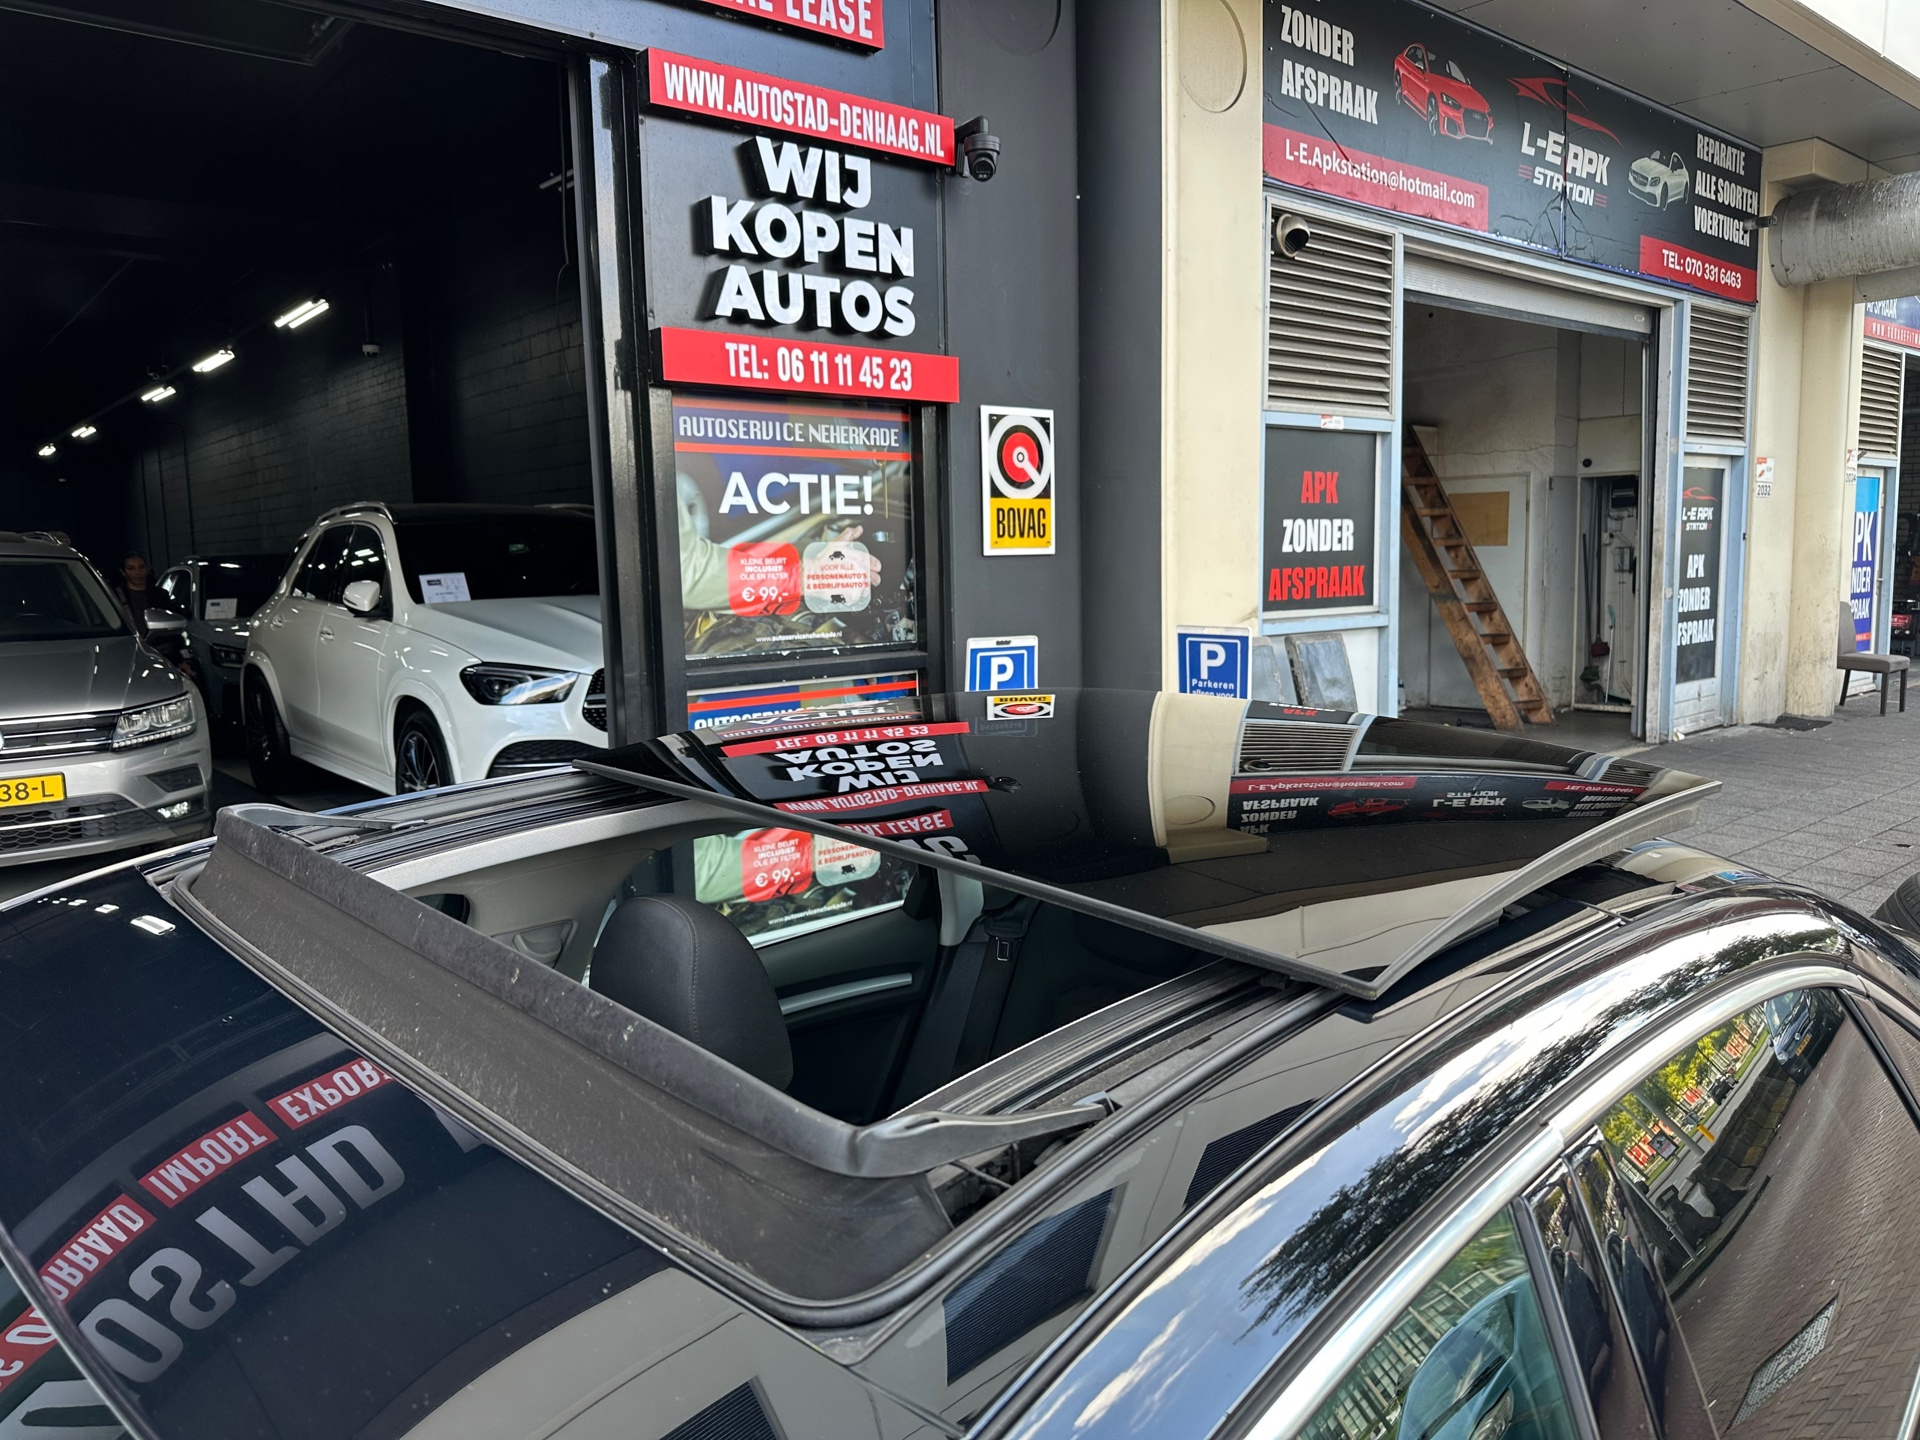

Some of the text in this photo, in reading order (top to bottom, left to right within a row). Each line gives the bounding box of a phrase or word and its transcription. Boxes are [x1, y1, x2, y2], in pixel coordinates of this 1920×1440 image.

[1281, 5, 1354, 67] ZONDER
[1281, 58, 1378, 125] AFSPRAAK
[663, 61, 944, 158] WWW.AUTOSTAD-DENHAAG.NL
[1566, 142, 1610, 186] APK
[1697, 133, 1745, 176] REPARATIE
[755, 136, 872, 208] WIJ
[1285, 138, 1474, 209] L-E.Apkstation@hotmail.com
[1533, 166, 1594, 206] STATION
[1695, 170, 1758, 215] ALLE SOORTEN
[711, 195, 914, 277] KOPEN
[1662, 249, 1742, 289] TEL: 070 331 6463
[715, 265, 915, 337] AUTOS
[725, 342, 912, 391] TEL: 06 11 11 45 23
[679, 416, 899, 447] AUTOSERVICE NEHERKADE
[718, 471, 874, 516] ACTIE!
[1301, 471, 1339, 504] APK
[1757, 485, 1771, 496] 2032
[996, 507, 1047, 539] BOVAG
[1697, 507, 1714, 520] APK
[1282, 518, 1354, 553] ZONDER
[740, 573, 755, 581] OLIE
[767, 572, 789, 580] FILTER
[807, 573, 867, 581] PERSONENAUTO'S
[1268, 565, 1365, 601] AFSPRAAK
[1686, 554, 1705, 578] APK
[741, 586, 789, 603] € 99,-
[813, 582, 869, 590] BEDRIJFSAUTO'S
[1678, 587, 1710, 613] ZONDER
[756, 631, 842, 643] www.autoserviceneherkade.nl
[1200, 643, 1227, 680] P
[1192, 678, 1234, 690] Parkeren
[753, 859, 768, 868] OLIE
[780, 852, 800, 863] FILTER
[754, 839, 799, 852] KLEINE BEURT
[758, 847, 795, 859] INCLUSIEF
[755, 868, 801, 888] € 99,-
